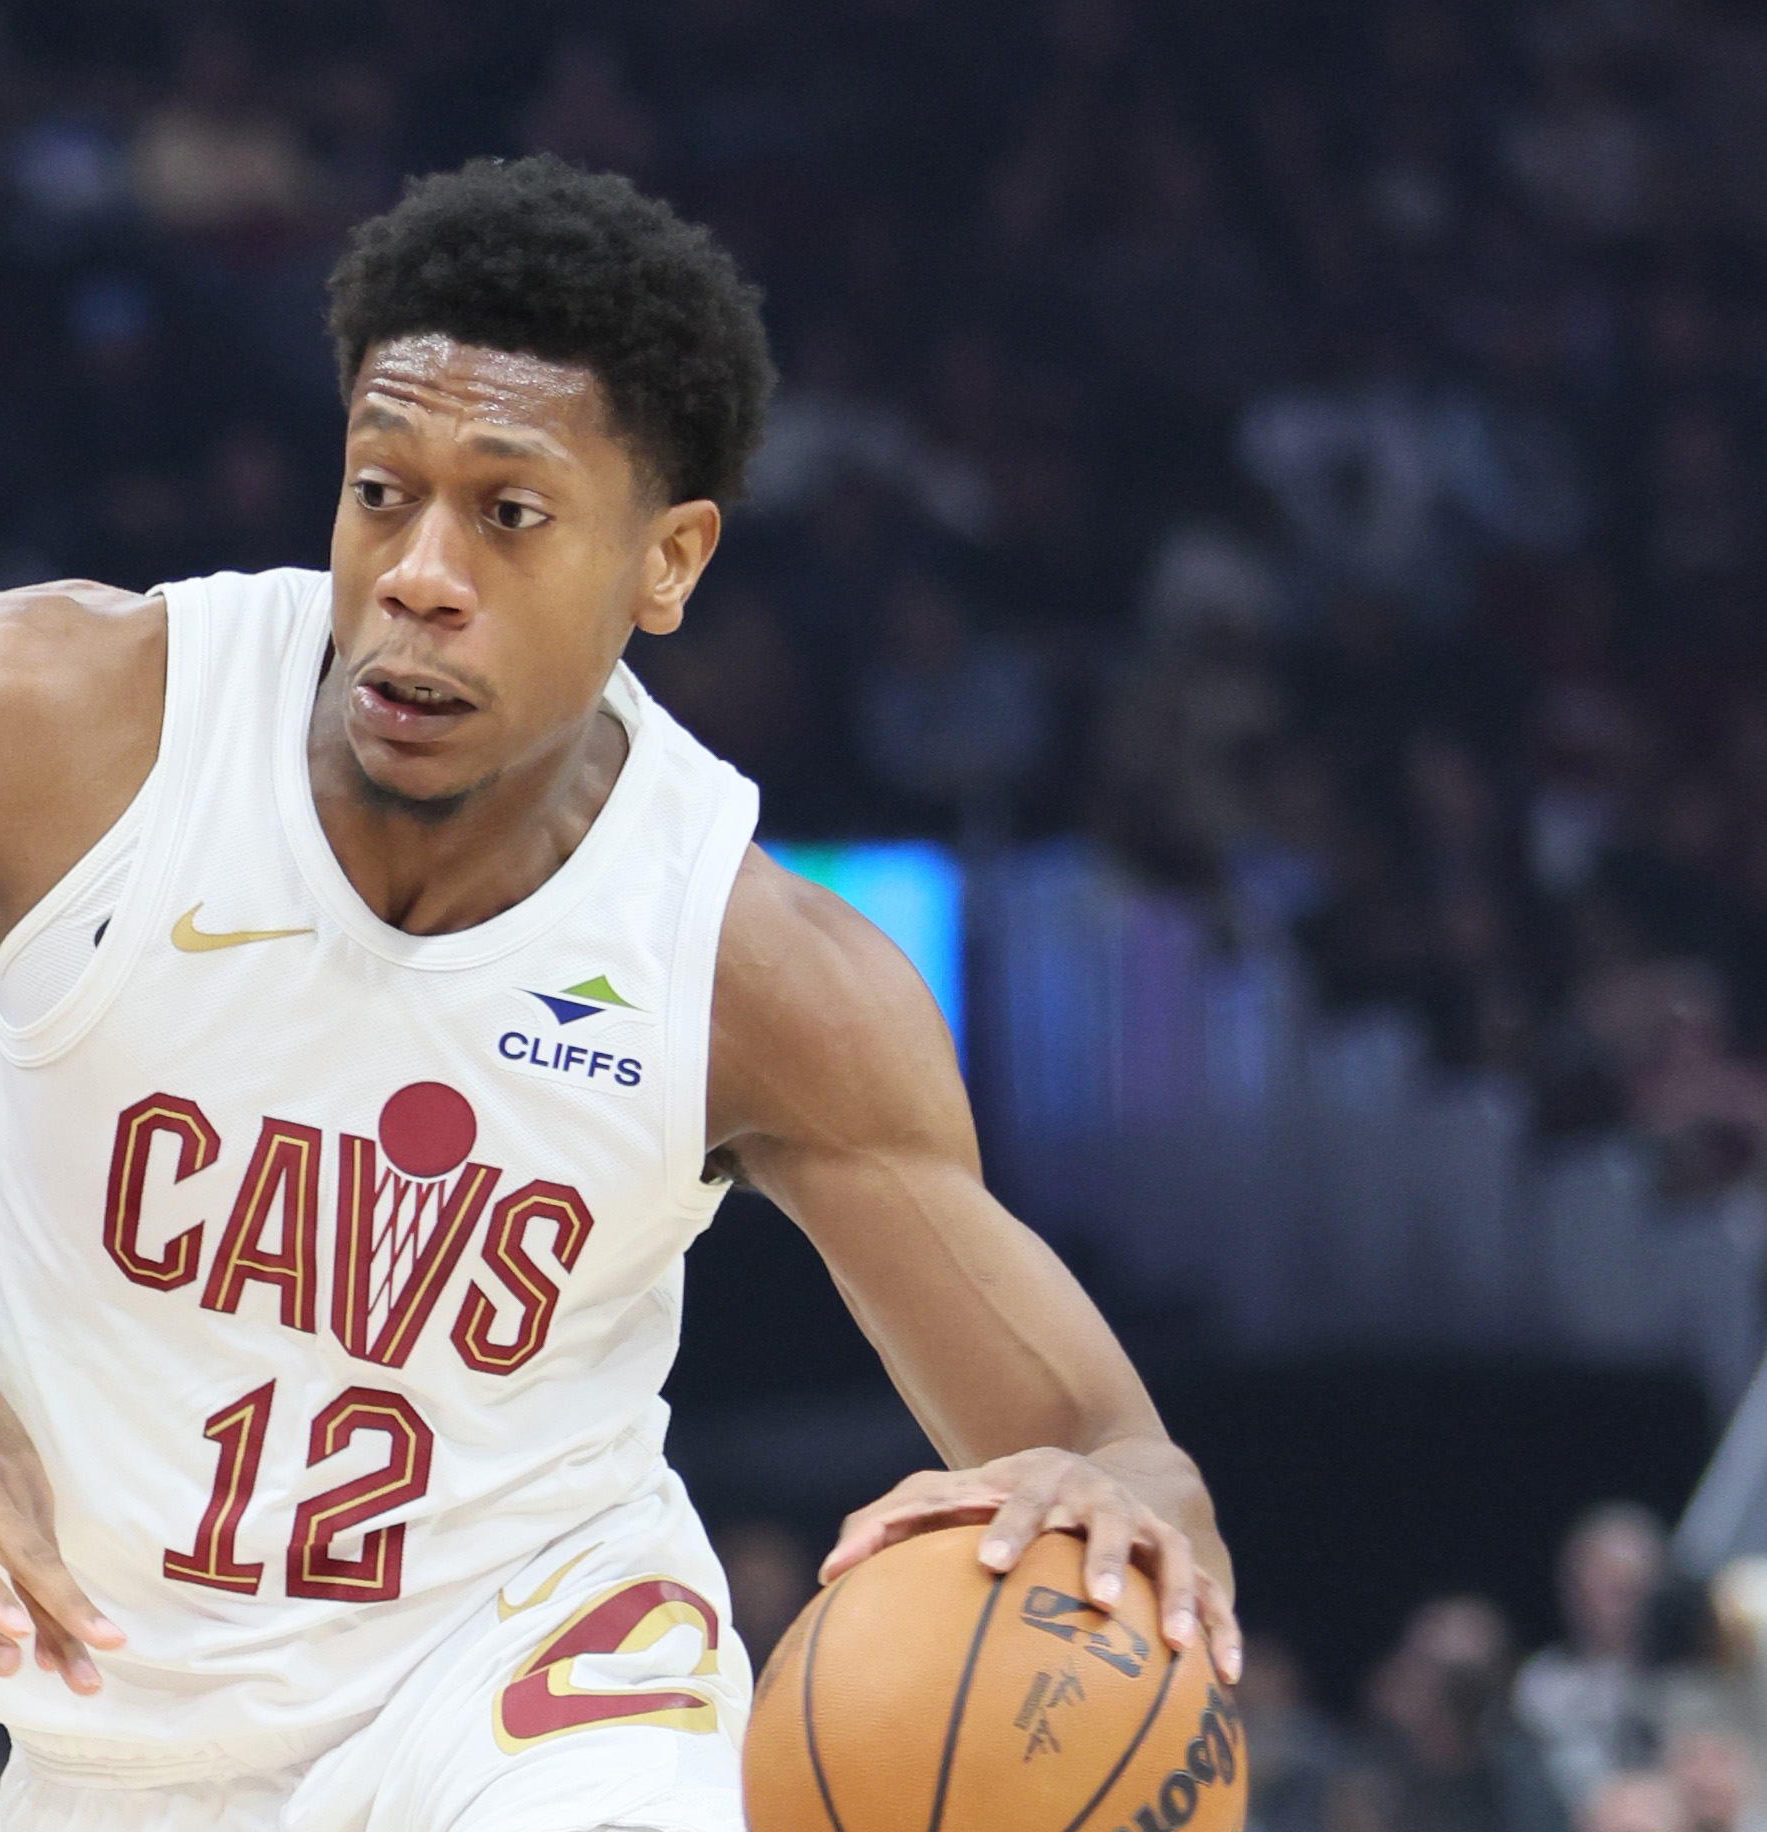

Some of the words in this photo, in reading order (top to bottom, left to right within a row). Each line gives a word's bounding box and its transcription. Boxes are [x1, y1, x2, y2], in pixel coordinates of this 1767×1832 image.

[498, 1031, 642, 1087] CLIFFS
[103, 1081, 595, 1376] CAVS
[162, 1378, 434, 1603] 12
